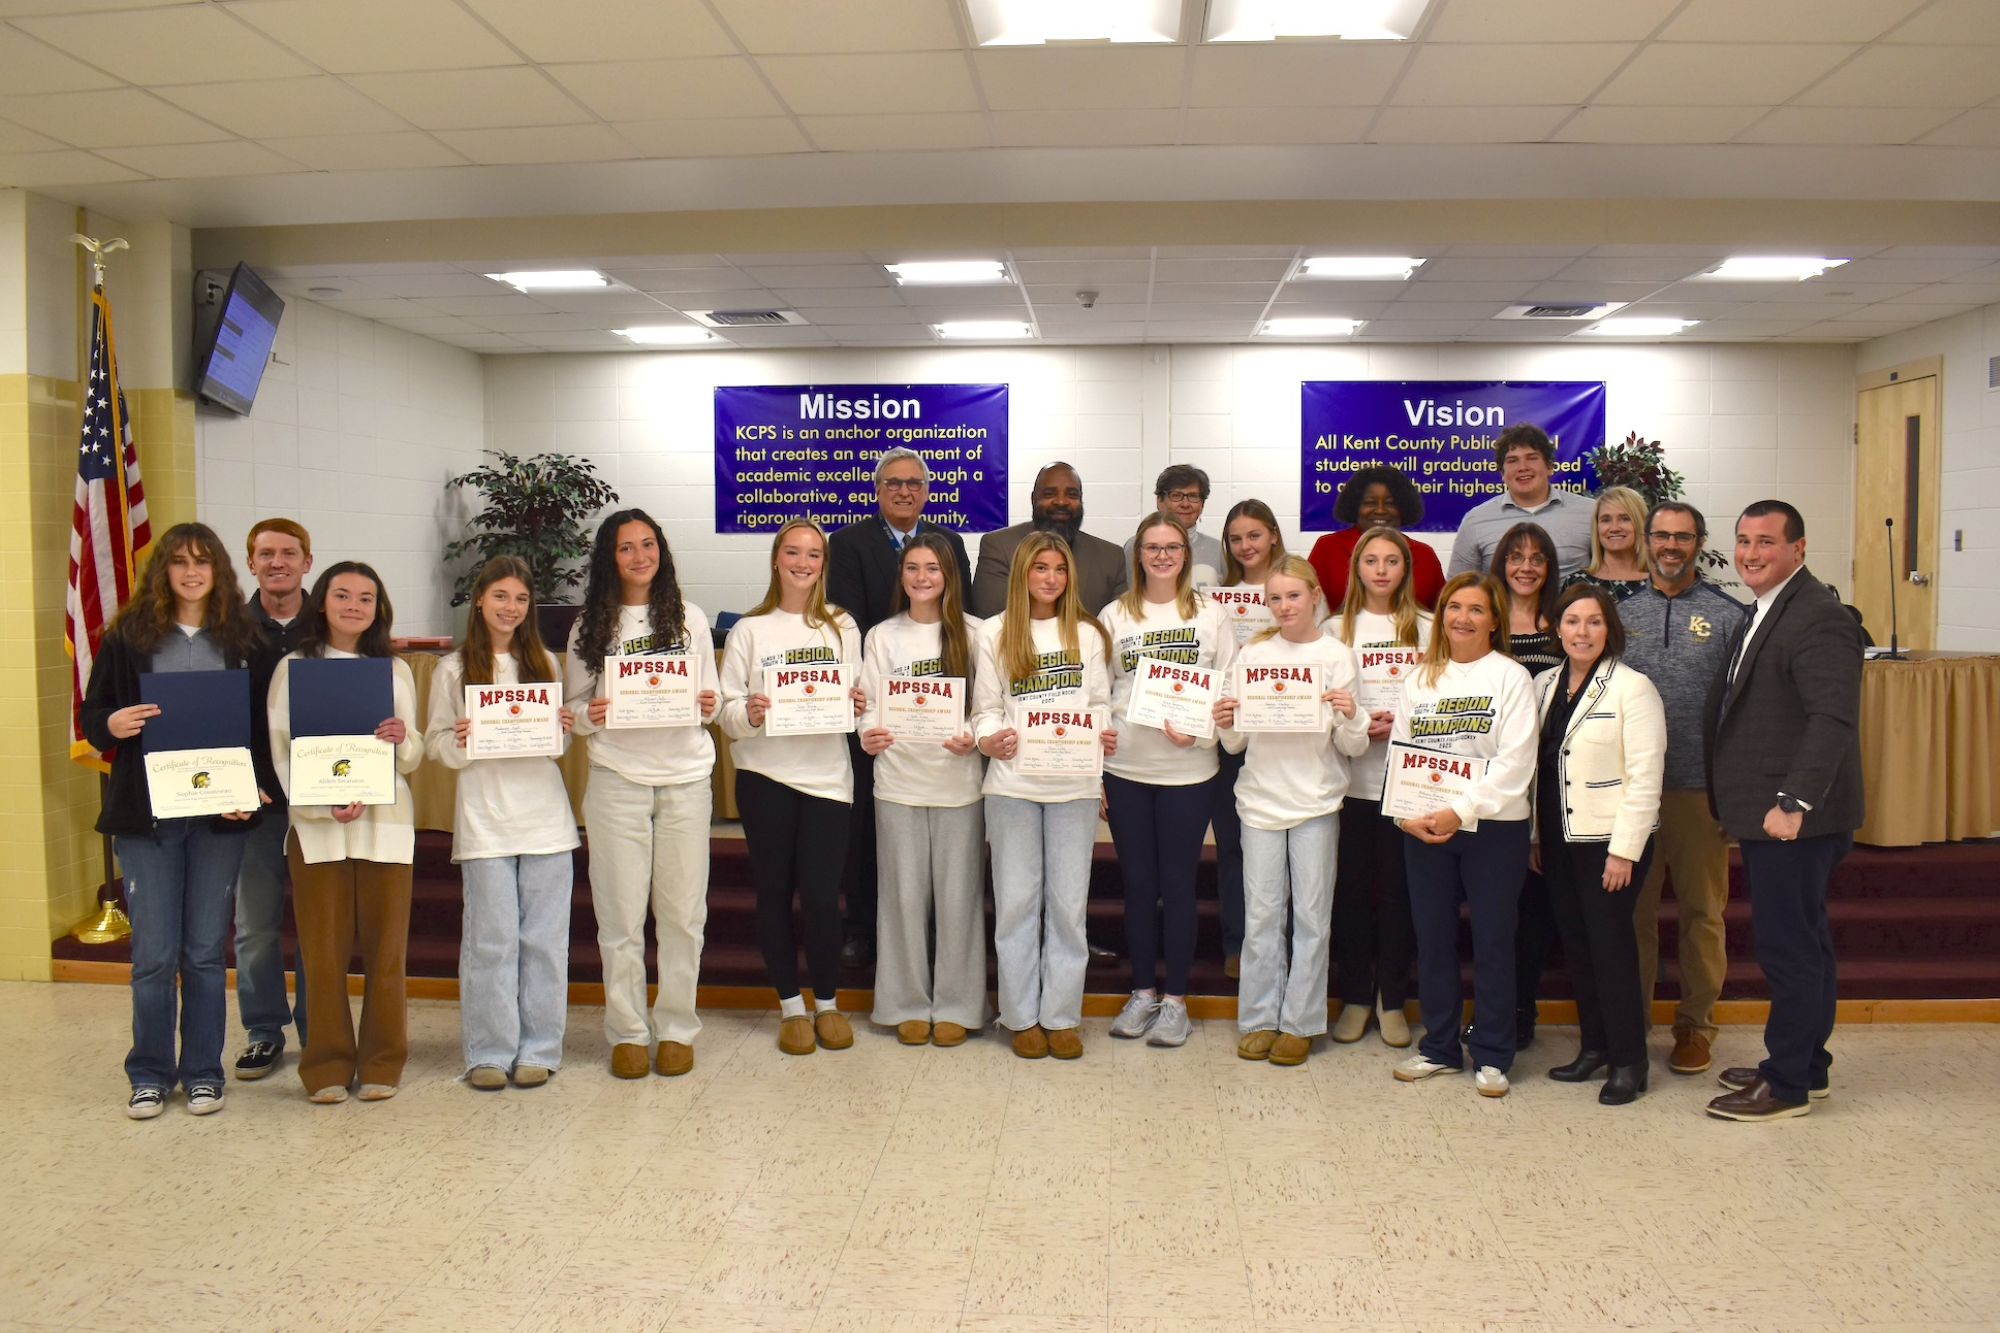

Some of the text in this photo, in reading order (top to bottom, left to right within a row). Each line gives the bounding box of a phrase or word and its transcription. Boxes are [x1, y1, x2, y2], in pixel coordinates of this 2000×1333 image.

[800, 394, 920, 419] Mission
[1403, 399, 1505, 426] Vision
[736, 424, 987, 442] KCPS is an anchor organization
[735, 448, 767, 461] that
[771, 448, 828, 461] creates
[833, 450, 854, 461] an
[966, 444, 983, 460] of
[1315, 434, 1497, 453] All Kent County Public
[736, 467, 811, 482] academic
[973, 470, 983, 482] a
[1389, 456, 1417, 472] will
[1422, 456, 1498, 475] graduate
[736, 488, 842, 506] collaborative,
[929, 488, 959, 503] and
[1315, 480, 1332, 493] to
[1411, 478, 1444, 494] heir
[1448, 478, 1508, 497] highest
[1143, 627, 1195, 647] REGION
[785, 646, 836, 665] REGION
[619, 661, 688, 679] MPSSAA
[912, 658, 943, 677] REGI
[1246, 668, 1313, 684] MPSSAA
[777, 669, 842, 688] MPSSAA
[1009, 671, 1083, 697] CHAMPIONS
[1148, 664, 1211, 691] MPSSAA
[480, 688, 550, 708] MPSSAA
[889, 680, 953, 699] MPSSAA
[1435, 696, 1494, 714] REGION
[1028, 711, 1093, 730] MPSSAA
[1409, 716, 1493, 739] CHAMPIONS
[297, 745, 333, 758] Certificate
[335, 743, 343, 754] of
[345, 743, 389, 756] Recognition
[152, 759, 190, 773] Certificate
[192, 757, 200, 767] of
[201, 756, 247, 768] Recognition
[1402, 753, 1472, 780] MPSSAA
